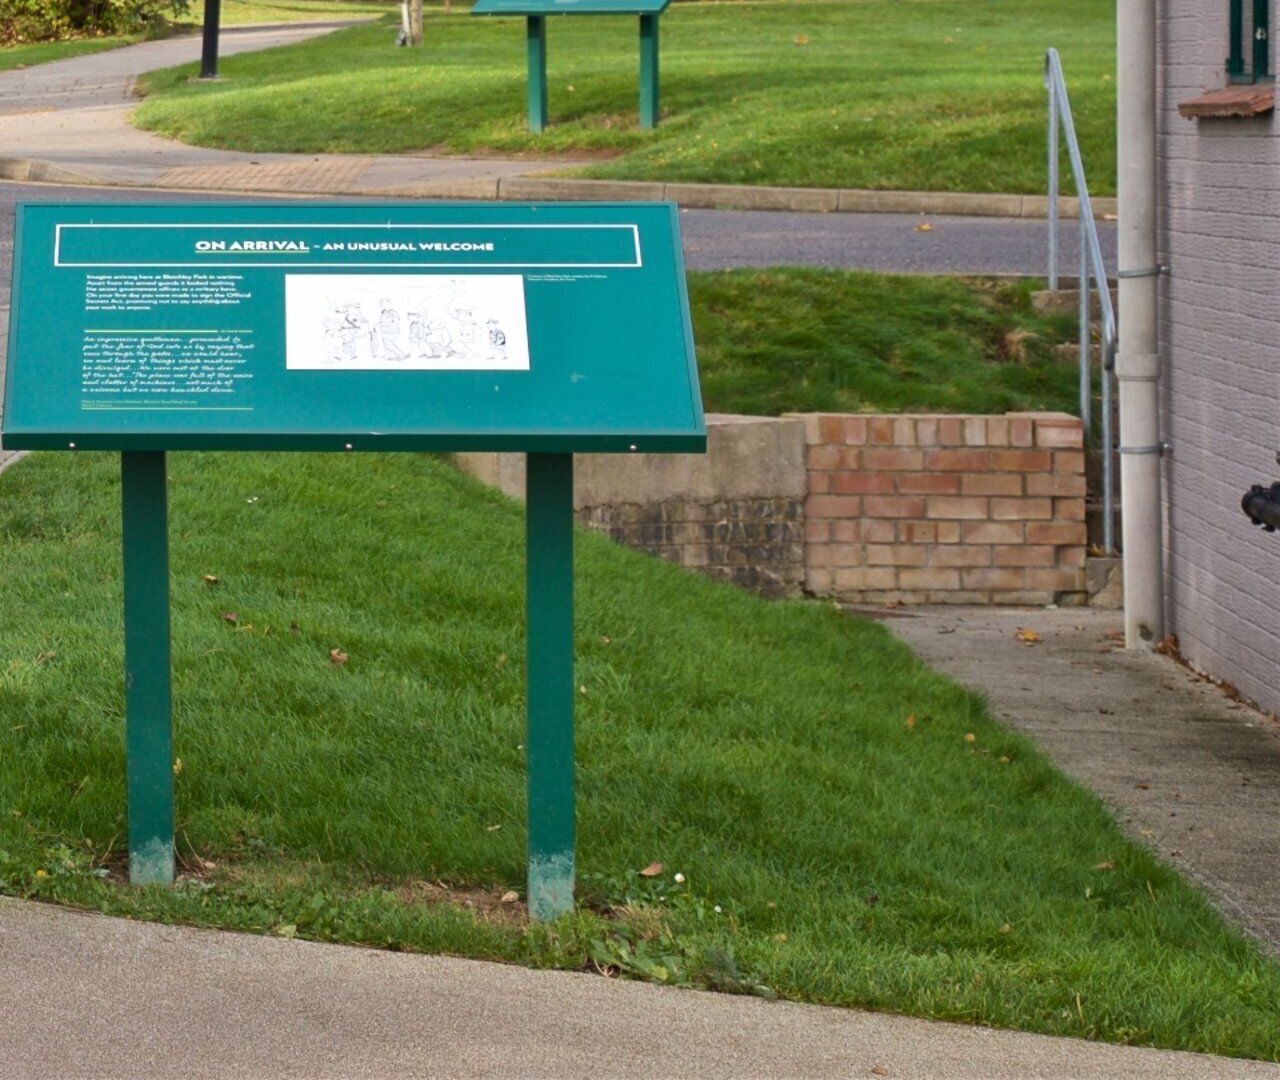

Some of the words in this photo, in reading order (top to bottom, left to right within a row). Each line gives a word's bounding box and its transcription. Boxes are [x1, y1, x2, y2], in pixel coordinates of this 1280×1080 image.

[195, 240, 227, 251] ON
[229, 240, 310, 251] ARRIVAL
[322, 242, 345, 251] AN
[347, 242, 417, 251] UNUSUAL
[419, 242, 495, 251] WELCOME
